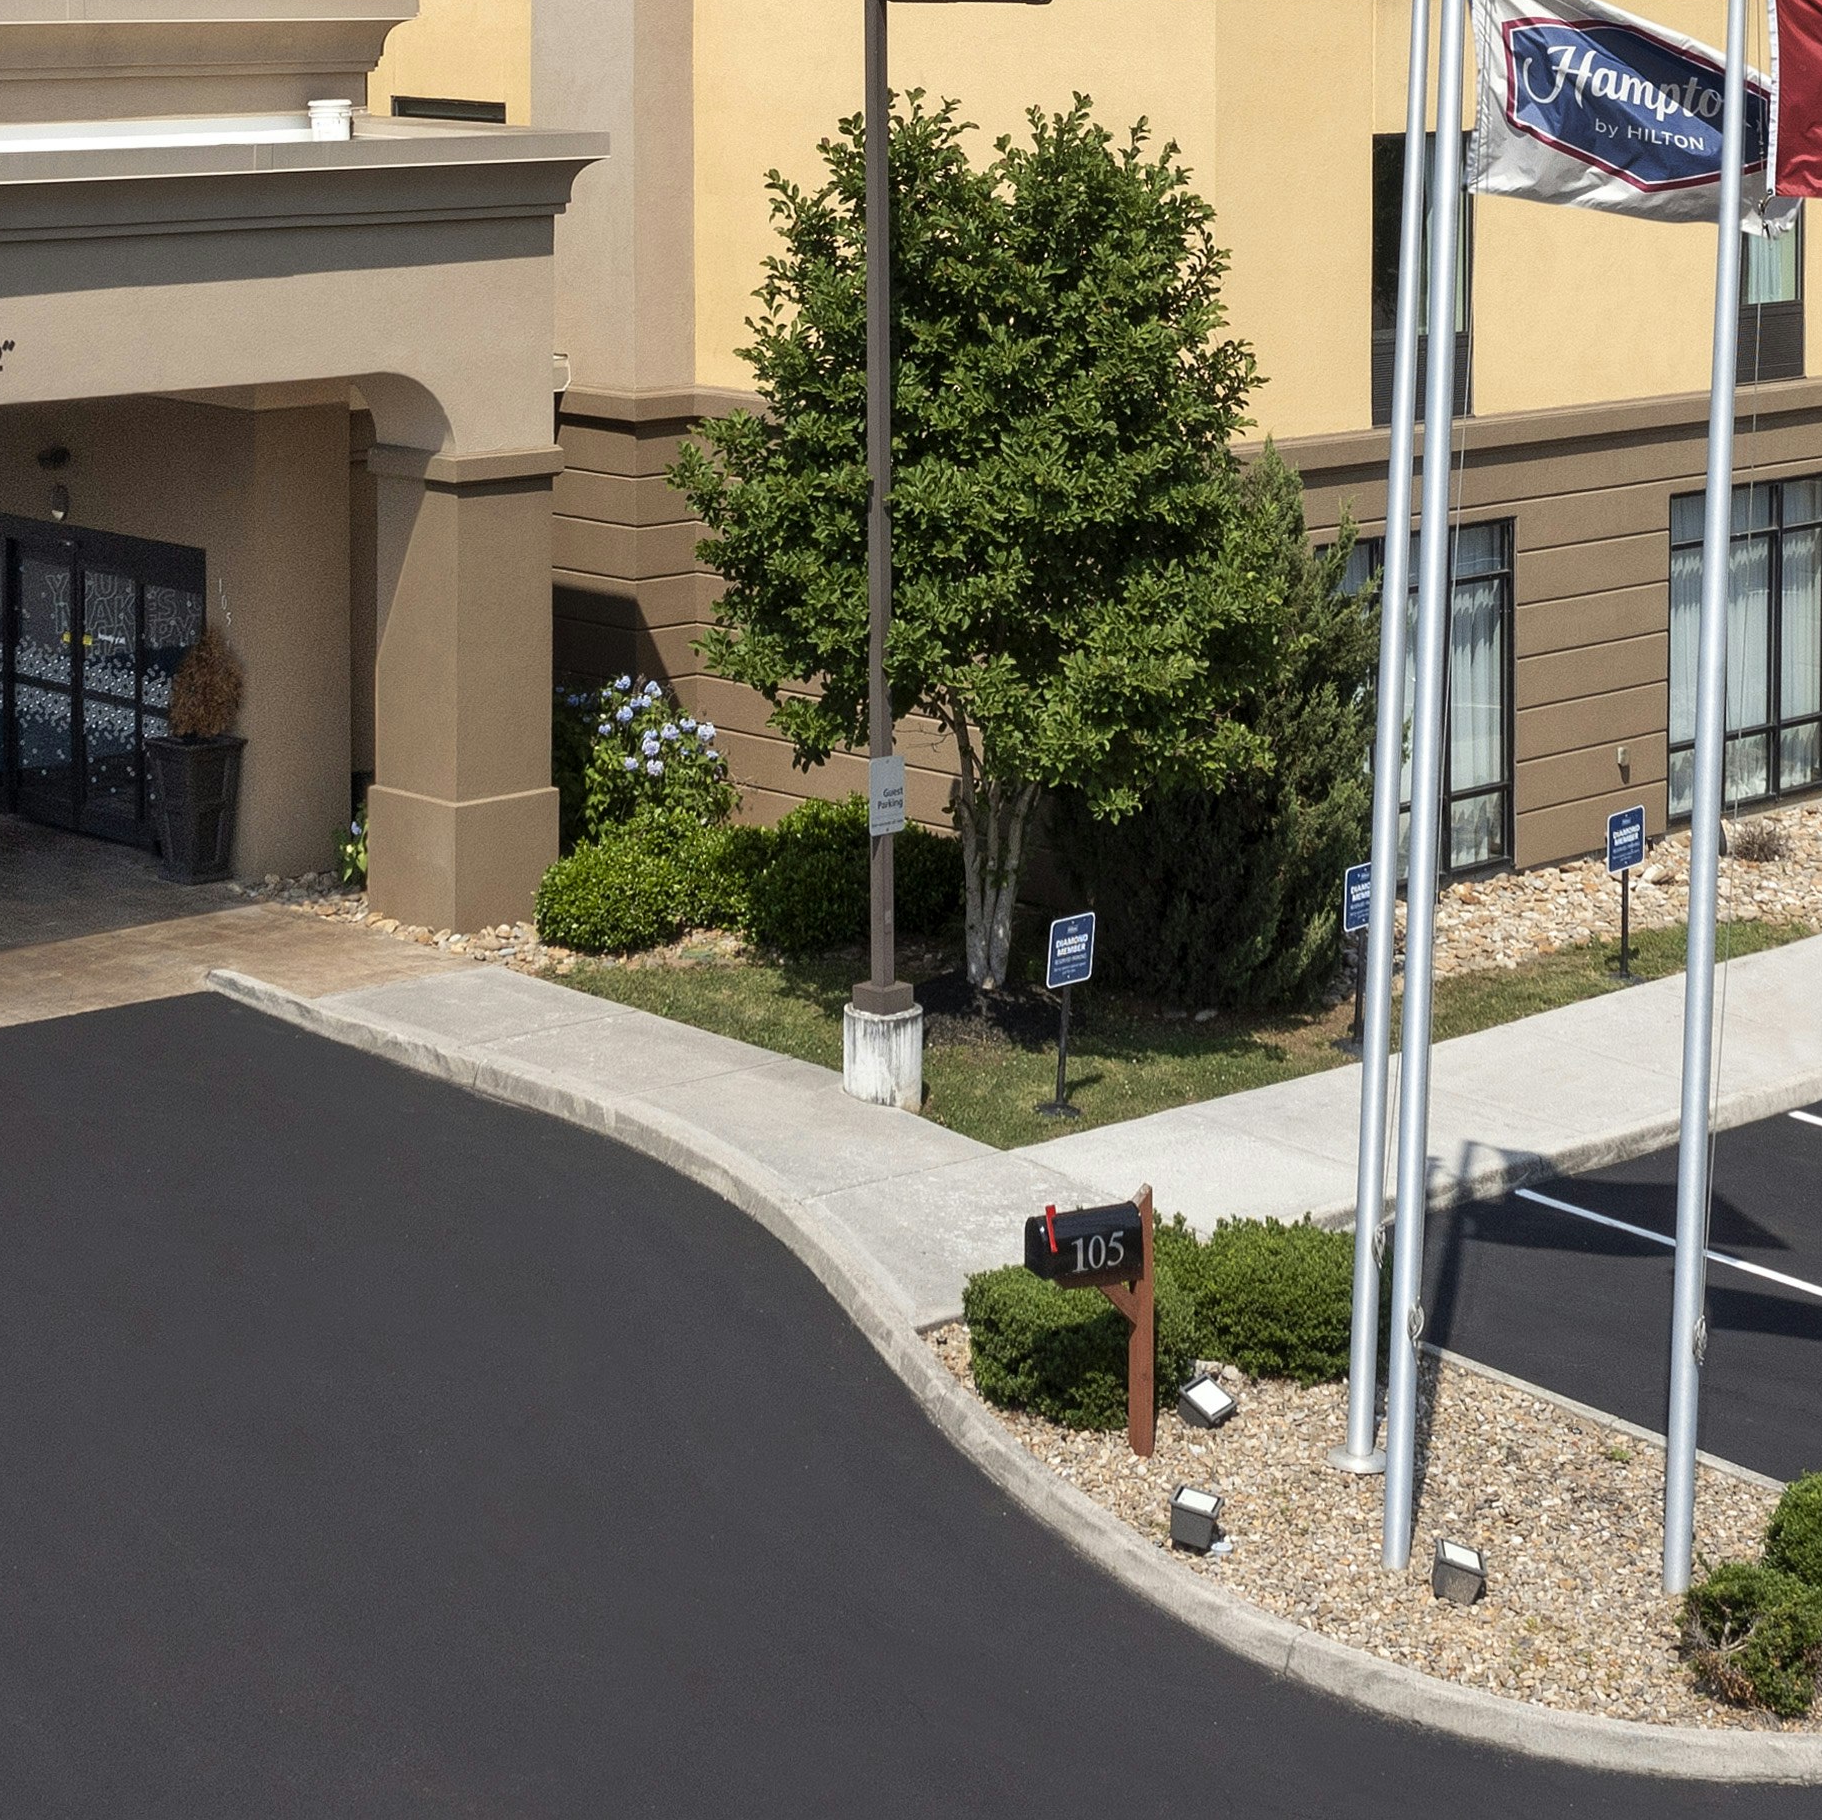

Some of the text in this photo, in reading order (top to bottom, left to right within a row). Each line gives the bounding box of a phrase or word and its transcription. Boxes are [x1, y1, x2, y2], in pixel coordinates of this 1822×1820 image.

[1523, 45, 1724, 122] Hampto
[1595, 118, 1705, 151] by HILTON
[883, 786, 903, 798] Guest
[877, 798, 903, 810] Parking
[1612, 823, 1641, 839] DIAMOND
[1350, 881, 1371, 895] DIAMO
[1055, 933, 1089, 949] DIAMOND
[1056, 943, 1086, 957] MEMBER
[1071, 1230, 1125, 1273] 105
